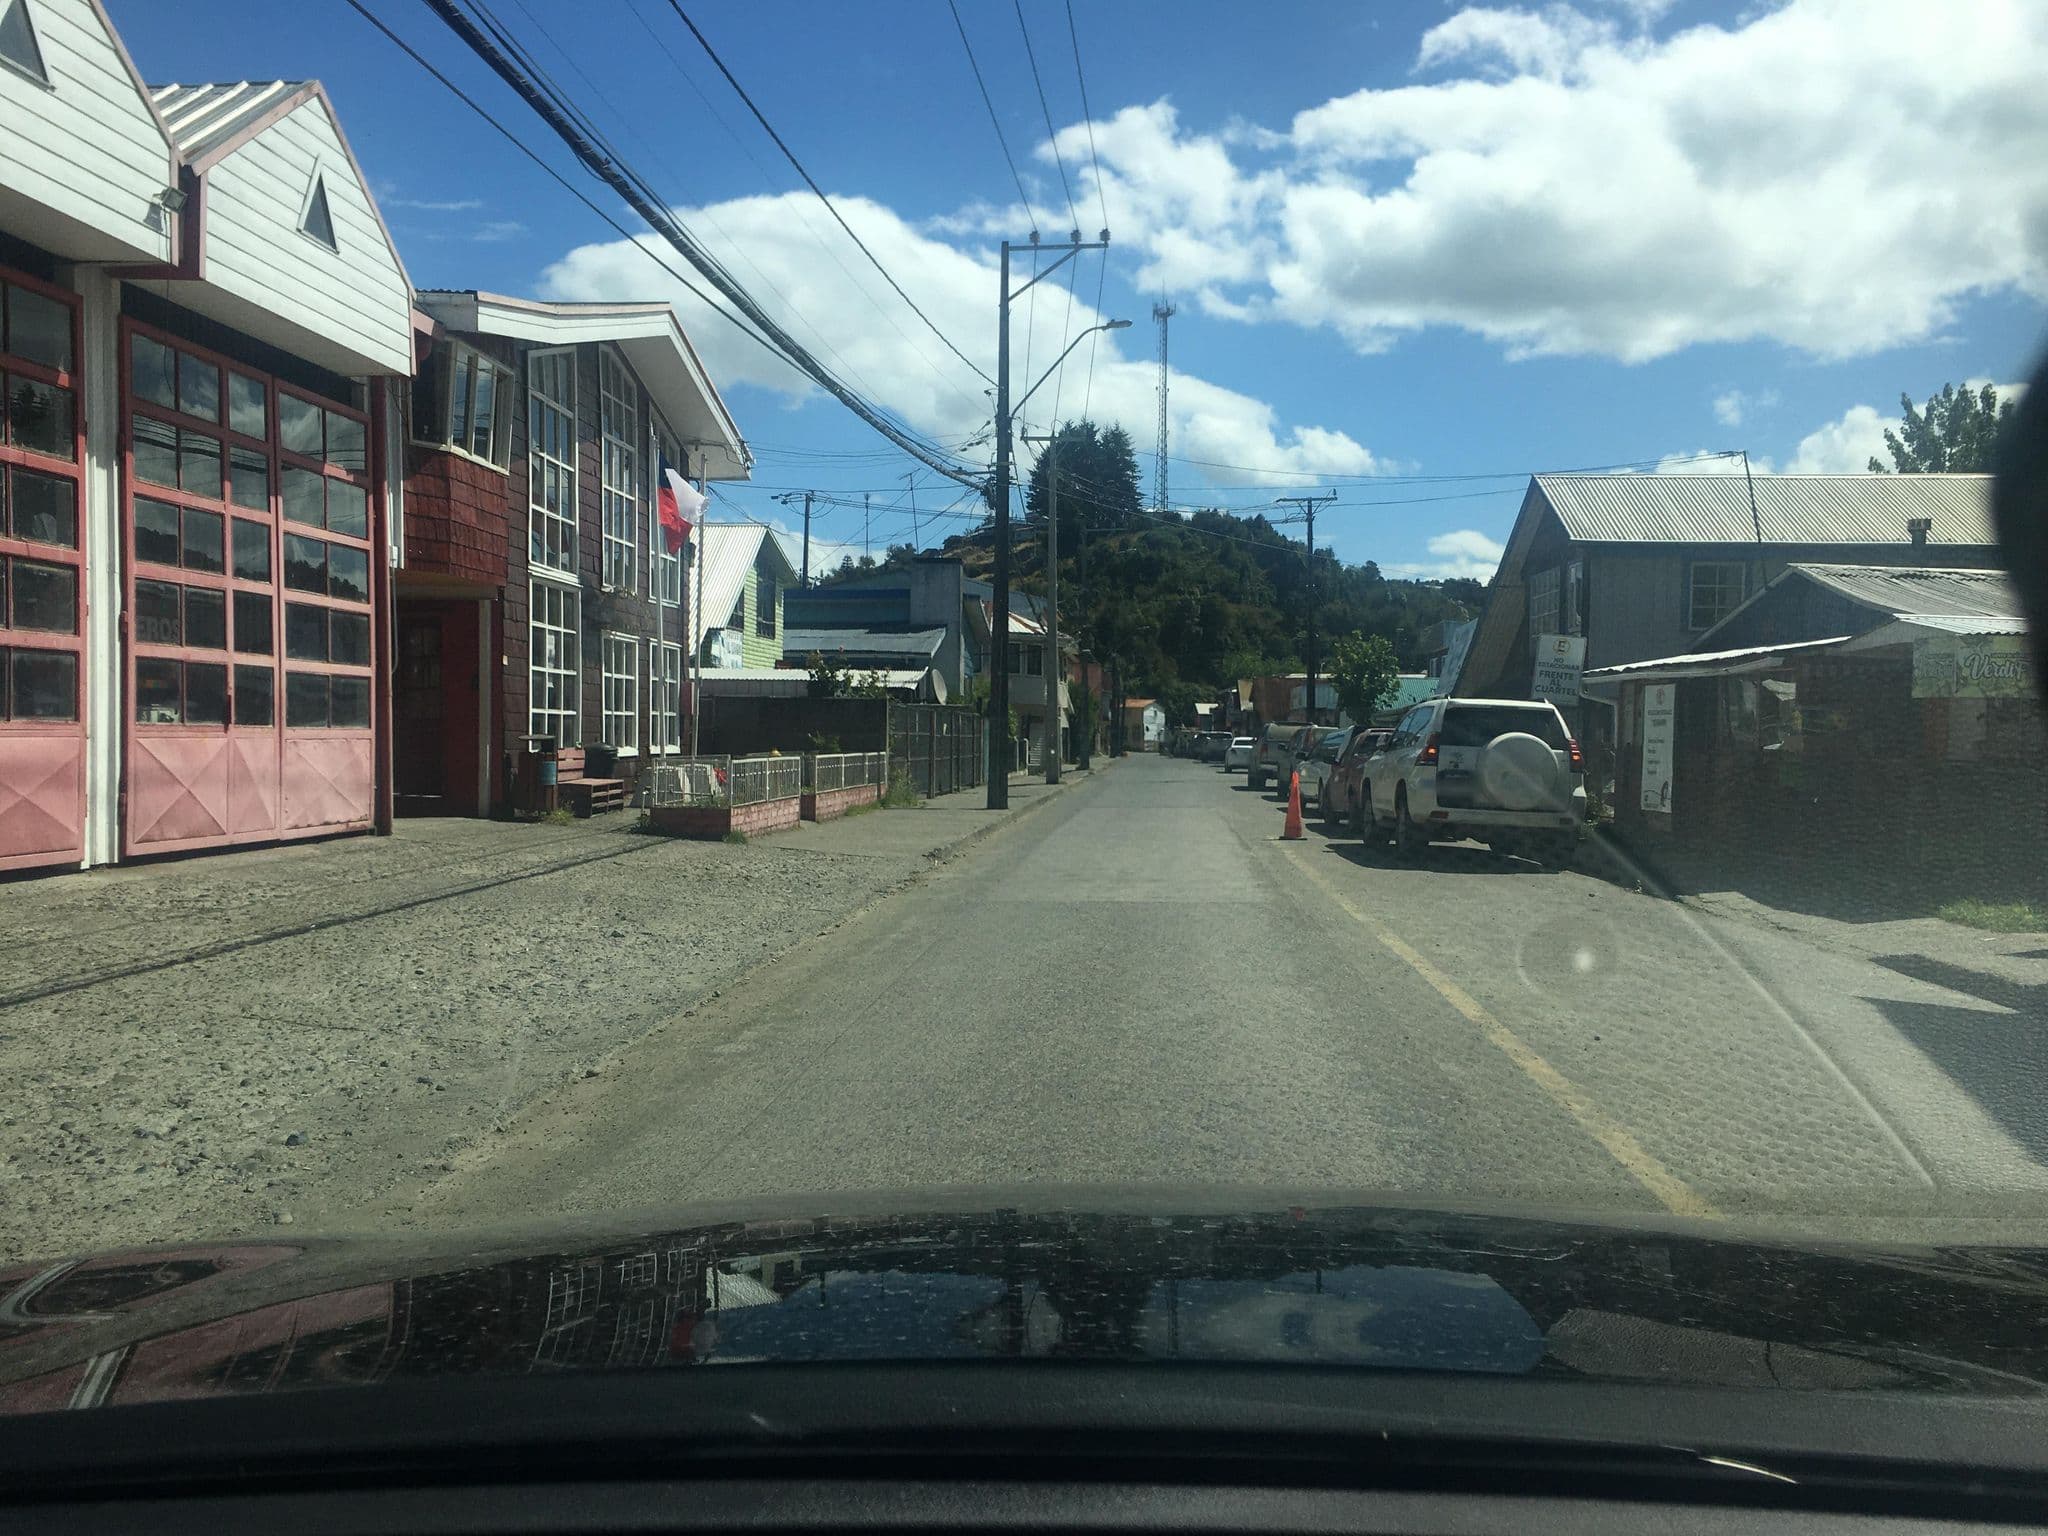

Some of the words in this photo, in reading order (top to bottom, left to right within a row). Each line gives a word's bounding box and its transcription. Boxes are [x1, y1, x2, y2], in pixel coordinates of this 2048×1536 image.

[1538, 661, 1580, 671] ESTACIONAR
[1539, 670, 1574, 681] FRENTE
[1549, 679, 1561, 687] AL
[1535, 684, 1578, 697] CUARTEL
